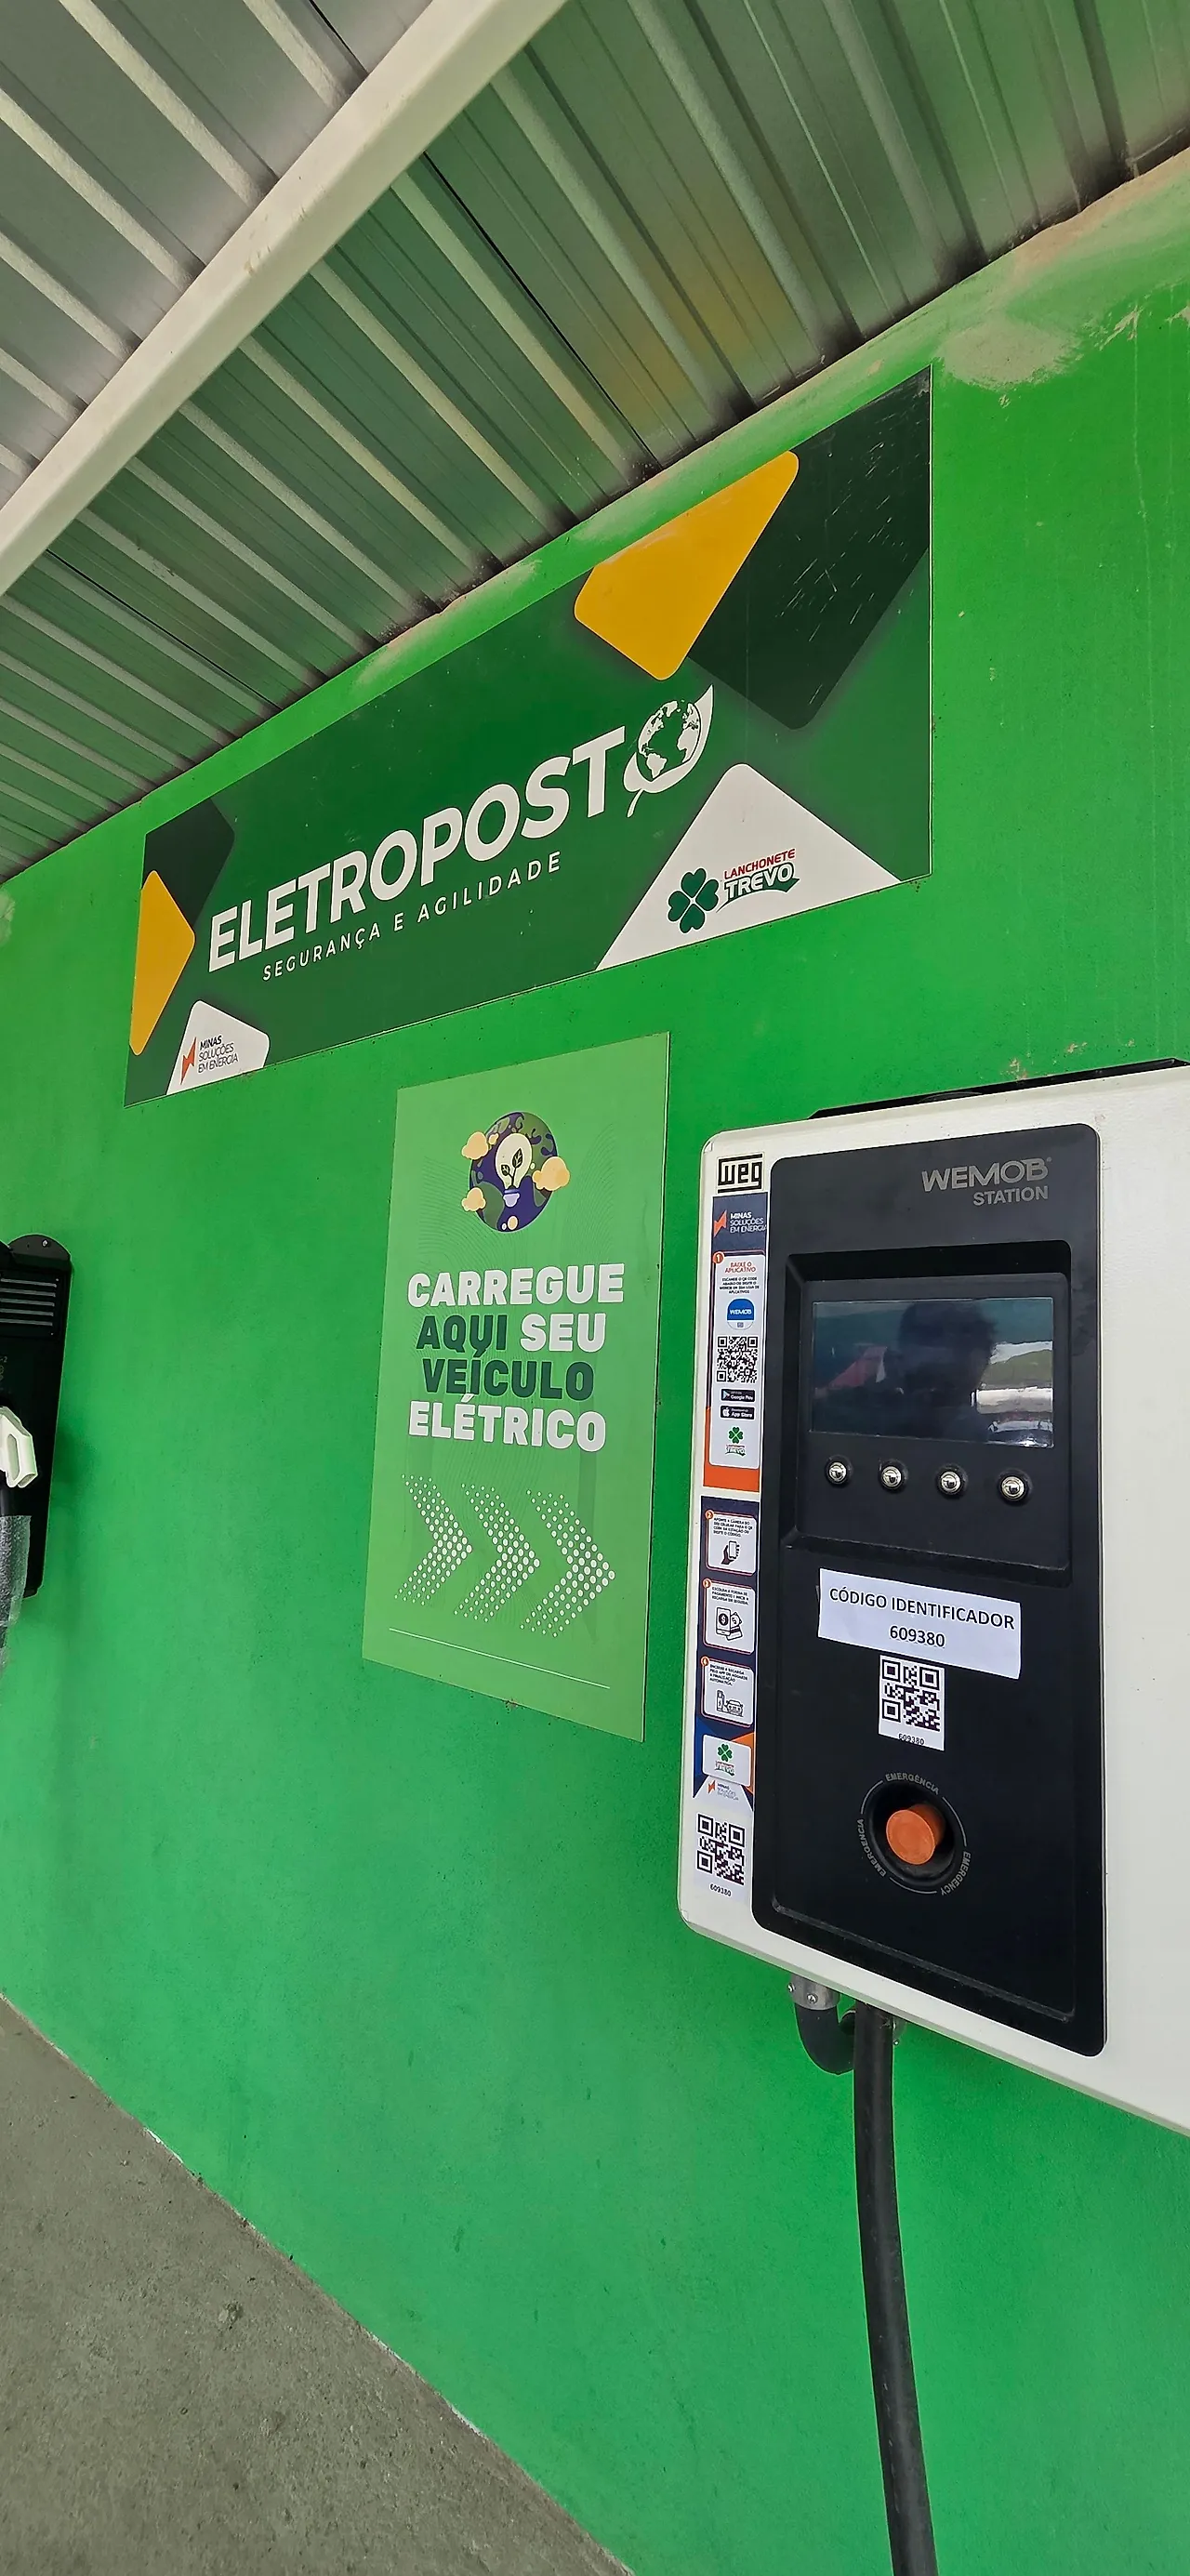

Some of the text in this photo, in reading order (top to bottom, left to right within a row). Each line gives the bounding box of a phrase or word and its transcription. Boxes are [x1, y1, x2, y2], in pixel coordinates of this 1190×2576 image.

[723, 863, 796, 900] TREVO
[724, 849, 795, 879] LANCHONETE
[262, 851, 561, 981] SEGURANÇA E AGILIDADE
[198, 1042, 234, 1063] SOLUÇÕES
[199, 1035, 222, 1050] MINAS
[973, 1185, 1048, 1207] STATION
[408, 1263, 625, 1307] CARREGUE
[416, 1313, 606, 1353] AQUI SEU
[422, 1349, 594, 1401] VEÍCULO
[409, 1393, 606, 1452] ELÉTRICO
[829, 1586, 1014, 1630] CÓDIGO IDENTIFICADOR
[890, 1625, 945, 1647] 609380
[898, 1733, 925, 1745] 609380
[941, 1851, 972, 1896] EMERGENCY
